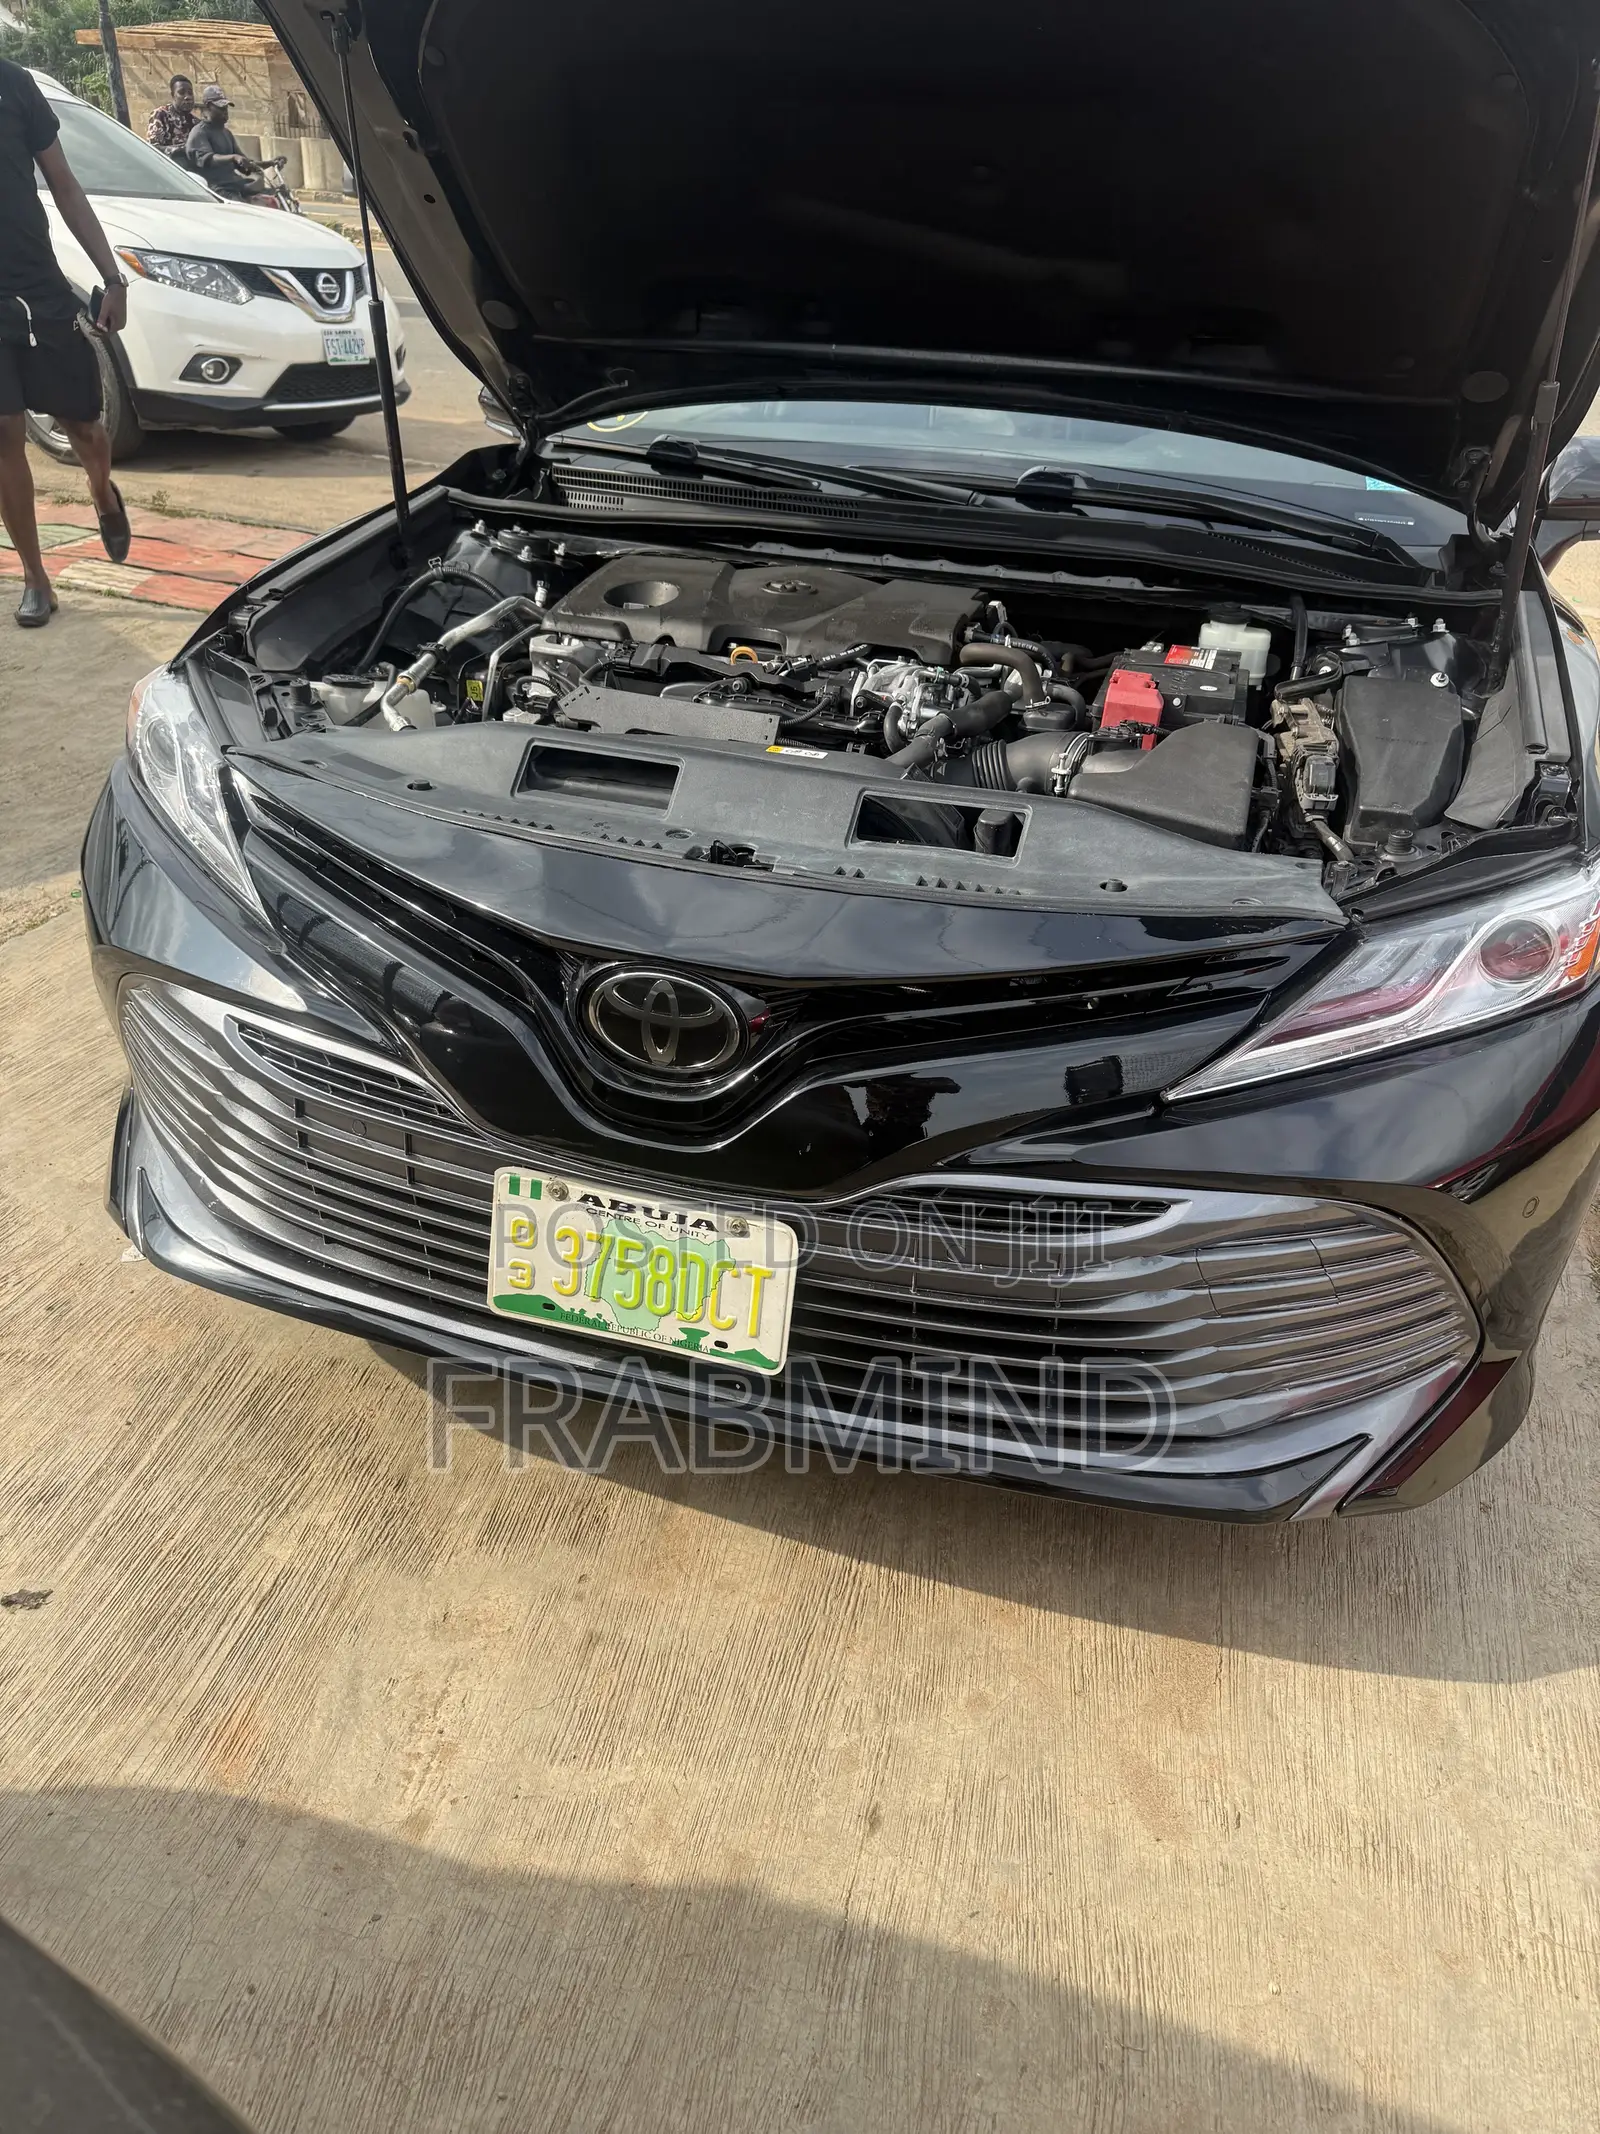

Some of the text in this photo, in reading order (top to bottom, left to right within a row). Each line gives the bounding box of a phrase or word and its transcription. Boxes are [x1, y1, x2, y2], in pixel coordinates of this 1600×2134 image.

[577, 1193, 719, 1232] ABUJA
[586, 1207, 710, 1240] CENTRE OF UNITY
[560, 1312, 711, 1353] FEDERAL REPUBLIC OF NIGERIA
